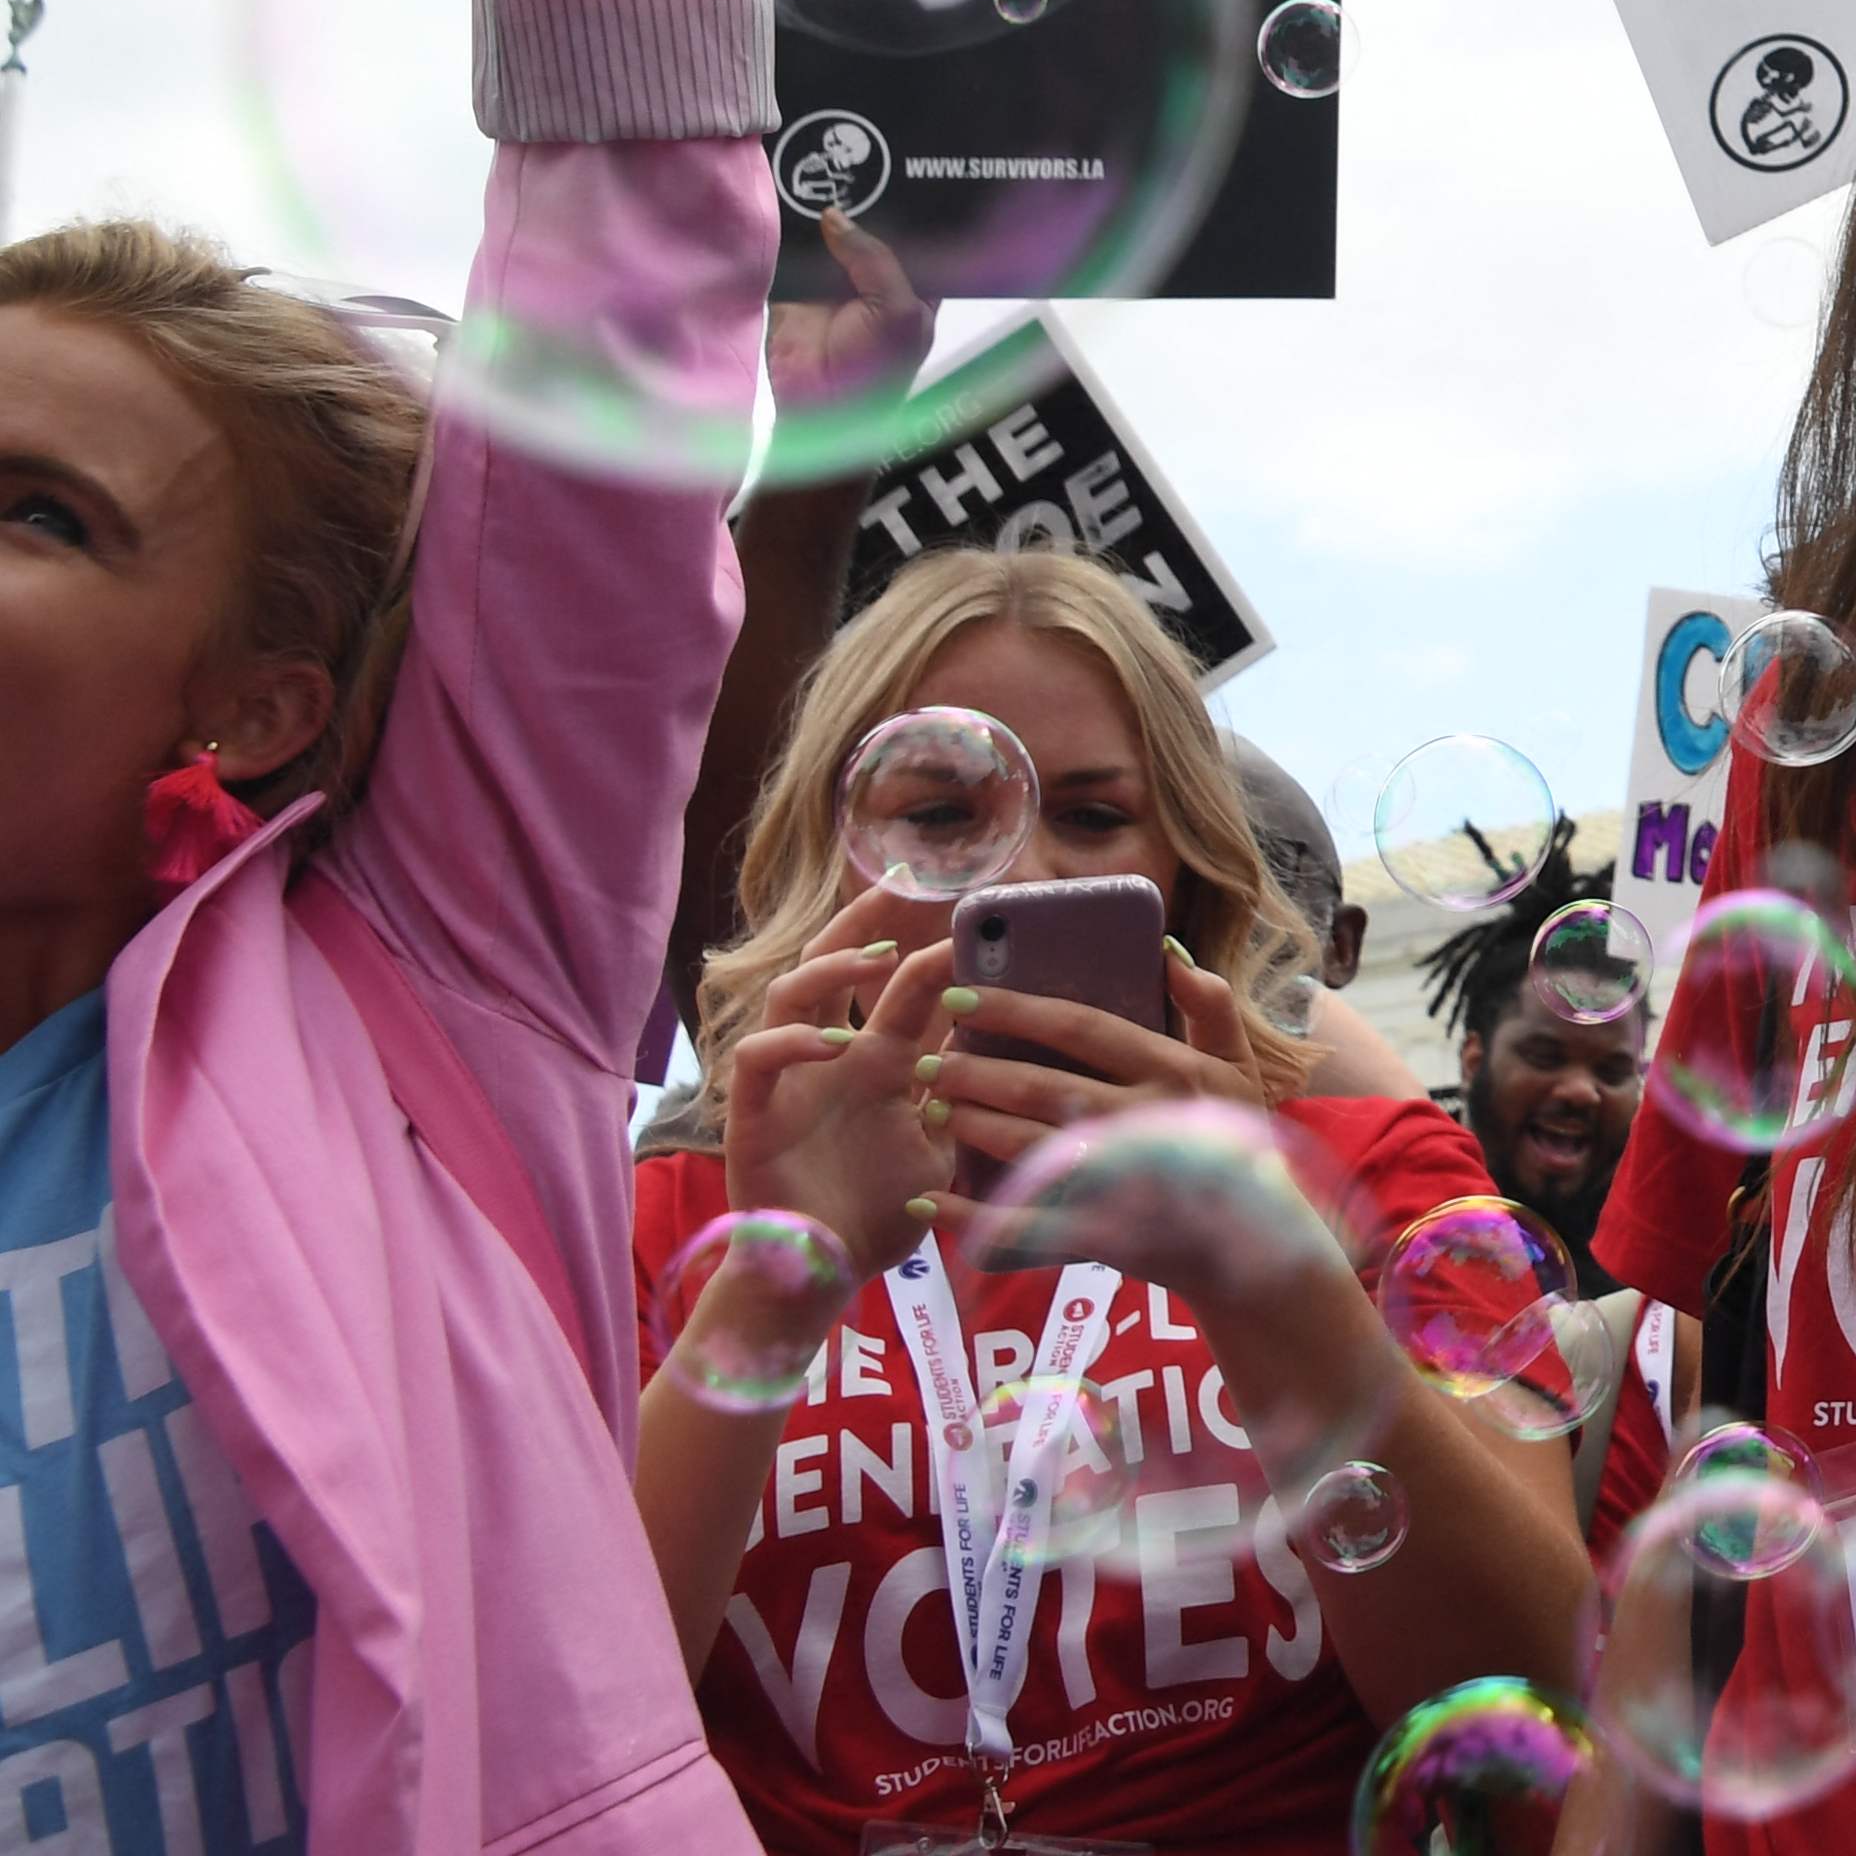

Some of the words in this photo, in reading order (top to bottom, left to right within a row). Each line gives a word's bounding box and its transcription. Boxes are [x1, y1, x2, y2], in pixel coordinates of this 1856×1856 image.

[905, 155, 1105, 181] WWW.SURVIVORS.LA
[860, 403, 1064, 557] THE
[911, 1302, 932, 1329] LIFE
[954, 1483, 968, 1512] LIFE
[957, 1520, 971, 1552] FOR
[999, 1604, 1017, 1643] FOR
[989, 1644, 1009, 1681] LIFE
